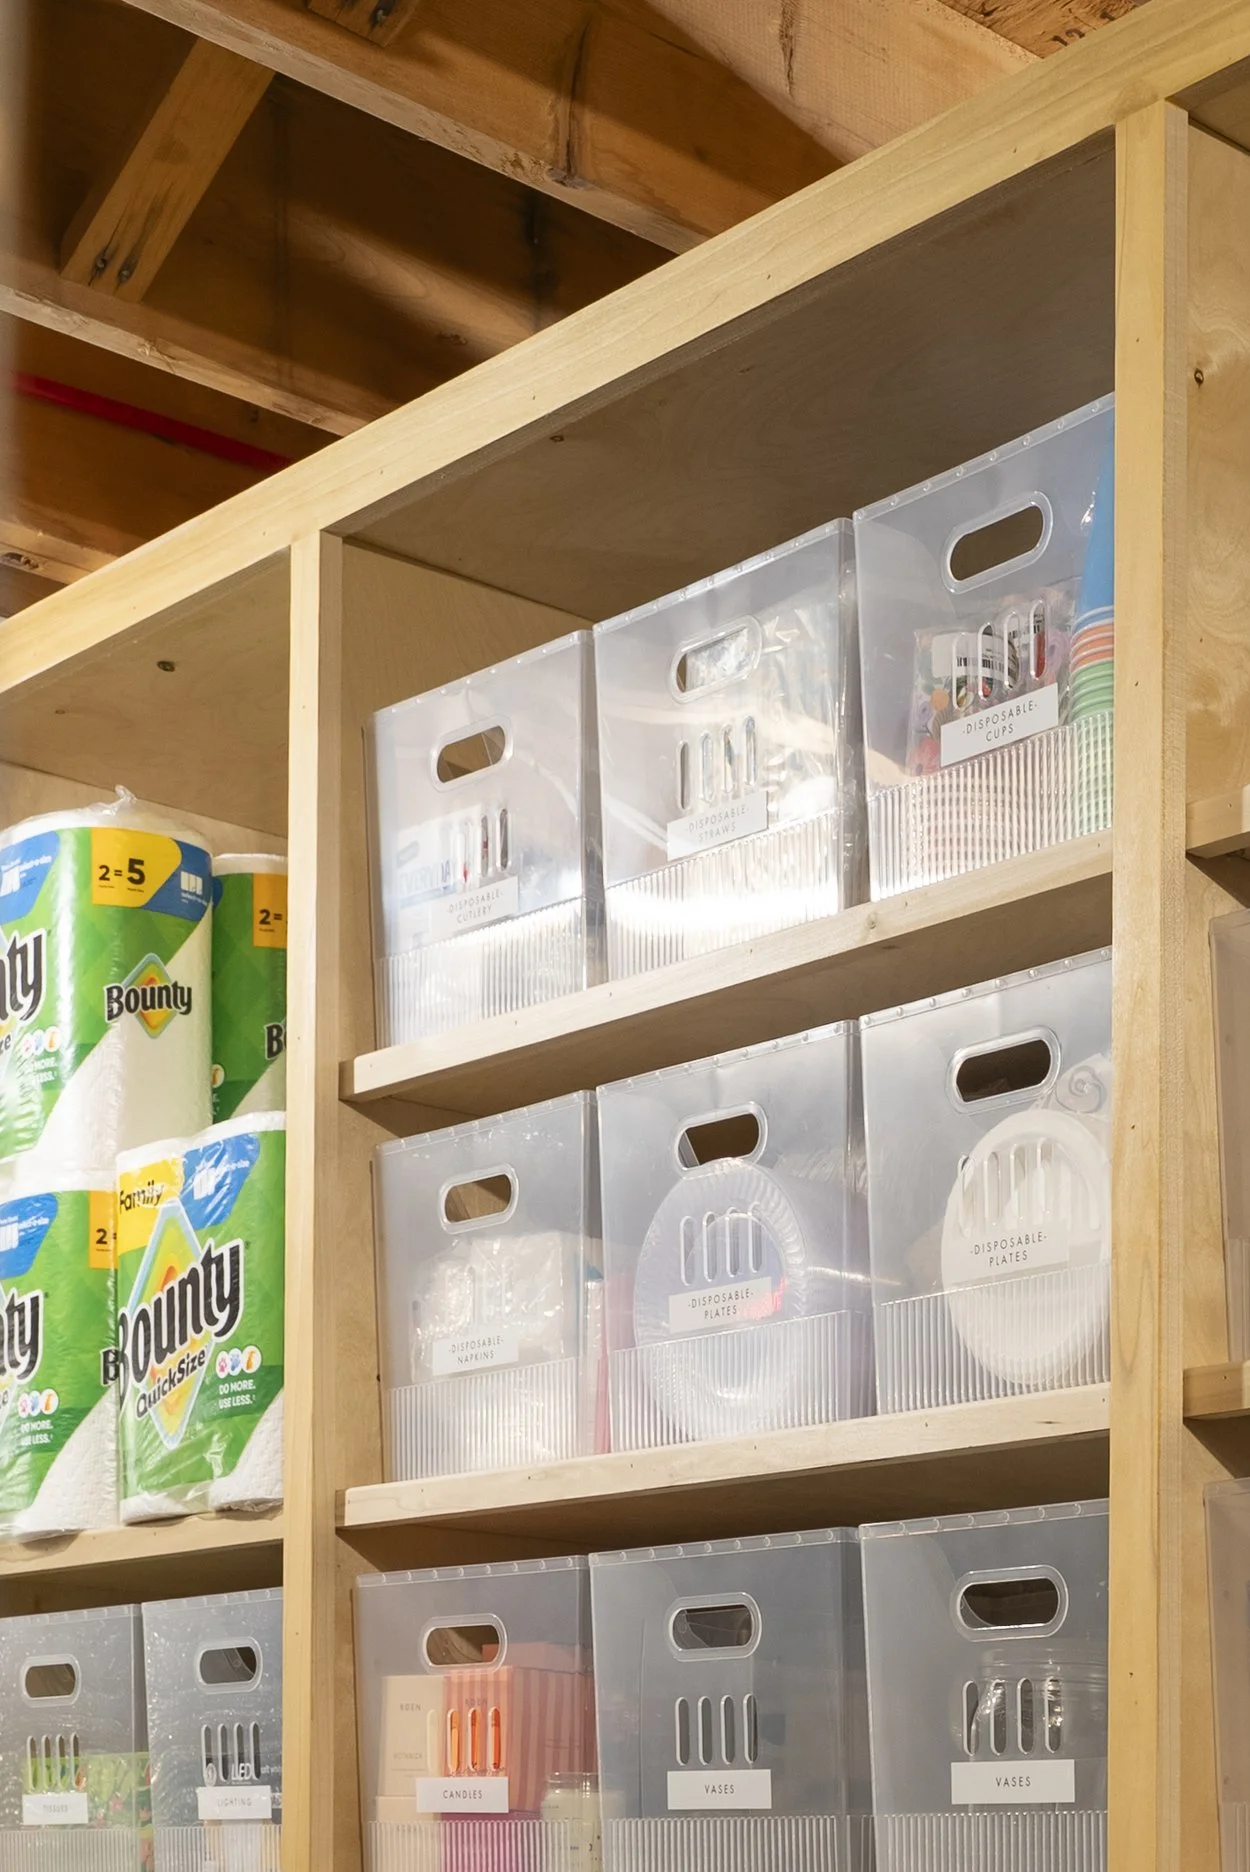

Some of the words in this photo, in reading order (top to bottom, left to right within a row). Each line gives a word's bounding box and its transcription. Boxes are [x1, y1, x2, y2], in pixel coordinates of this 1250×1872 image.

[986, 723, 1013, 742] CUPS
[699, 822, 735, 842] STRAWS
[99, 865, 110, 881] 2
[127, 858, 145, 884] 5
[259, 909, 271, 924] 2
[457, 904, 492, 923] CUTLERY
[105, 982, 191, 1021] Bounty
[96, 1229, 107, 1245] 2
[990, 1250, 1027, 1267] PLATES
[705, 1305, 737, 1319] PLATES
[458, 1350, 494, 1364] NAPKINS
[137, 1349, 206, 1418] QuickSize
[219, 1383, 229, 1395] DO
[231, 1764, 251, 1780] LED
[704, 1784, 735, 1794] VASES
[996, 1776, 1031, 1787] VASES
[217, 1797, 252, 1807] LIGHTING
[443, 1790, 482, 1799] CANDLES
